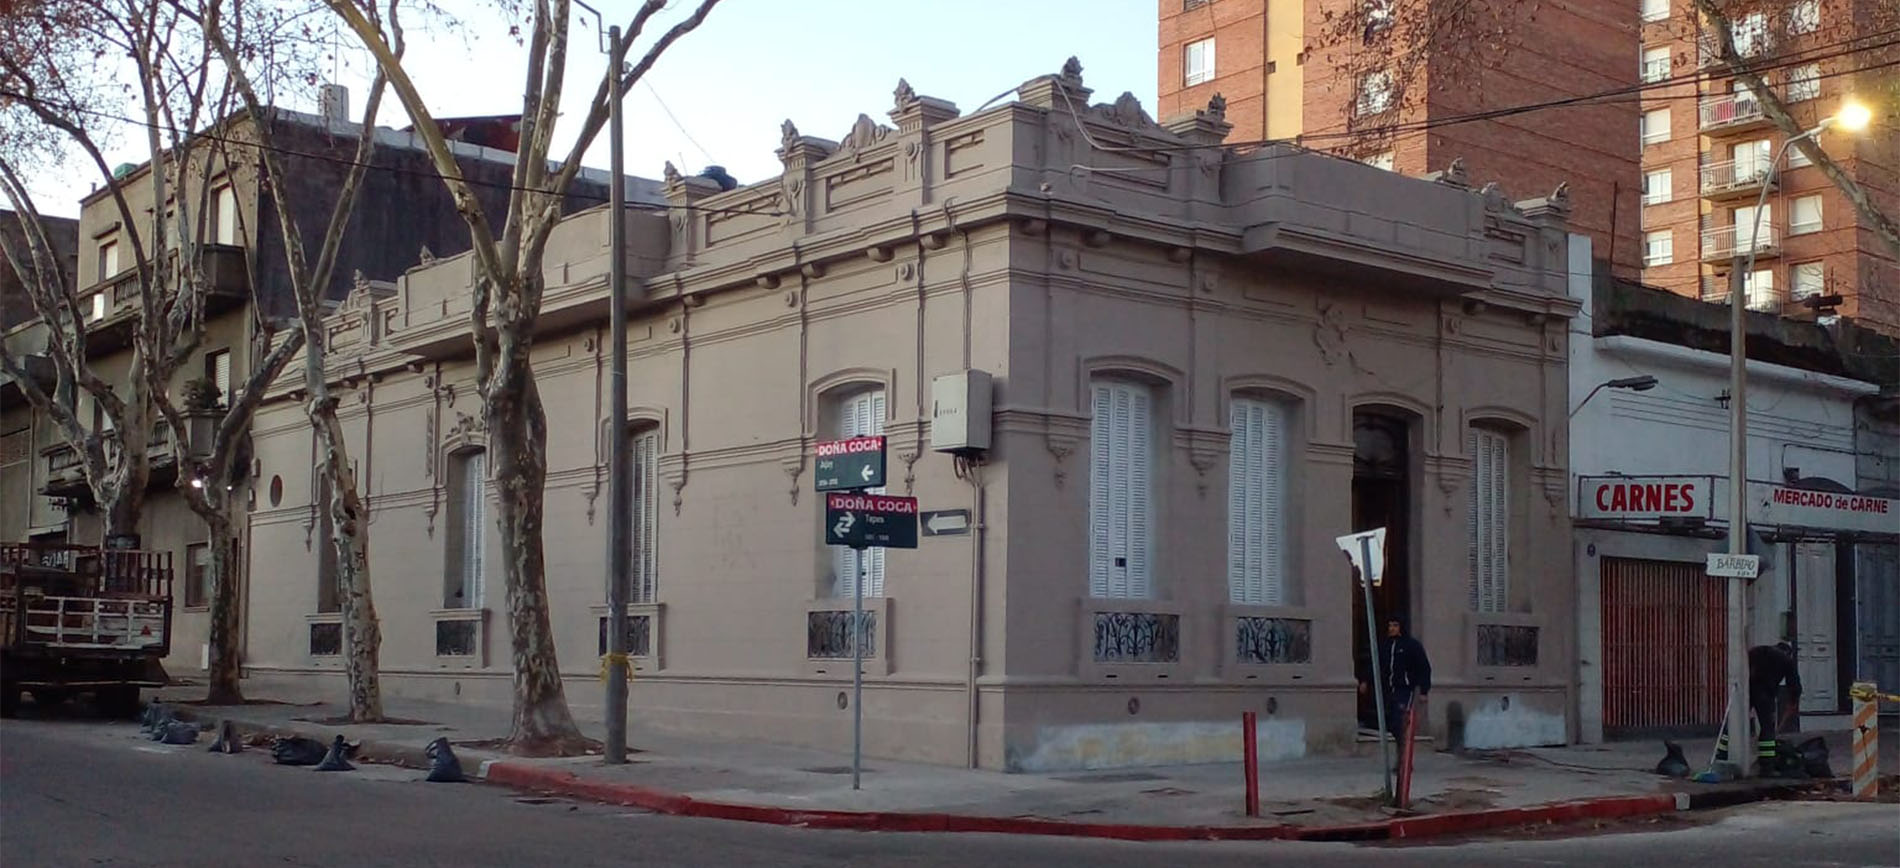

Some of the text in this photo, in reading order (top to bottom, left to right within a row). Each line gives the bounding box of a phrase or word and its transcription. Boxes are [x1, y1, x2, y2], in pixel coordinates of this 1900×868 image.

[818, 439, 878, 456] DOÑA COCA
[835, 497, 912, 513] DOÑA COCA
[1596, 484, 1695, 512] CARNES
[1774, 488, 1888, 513] MERCADO de CARNE
